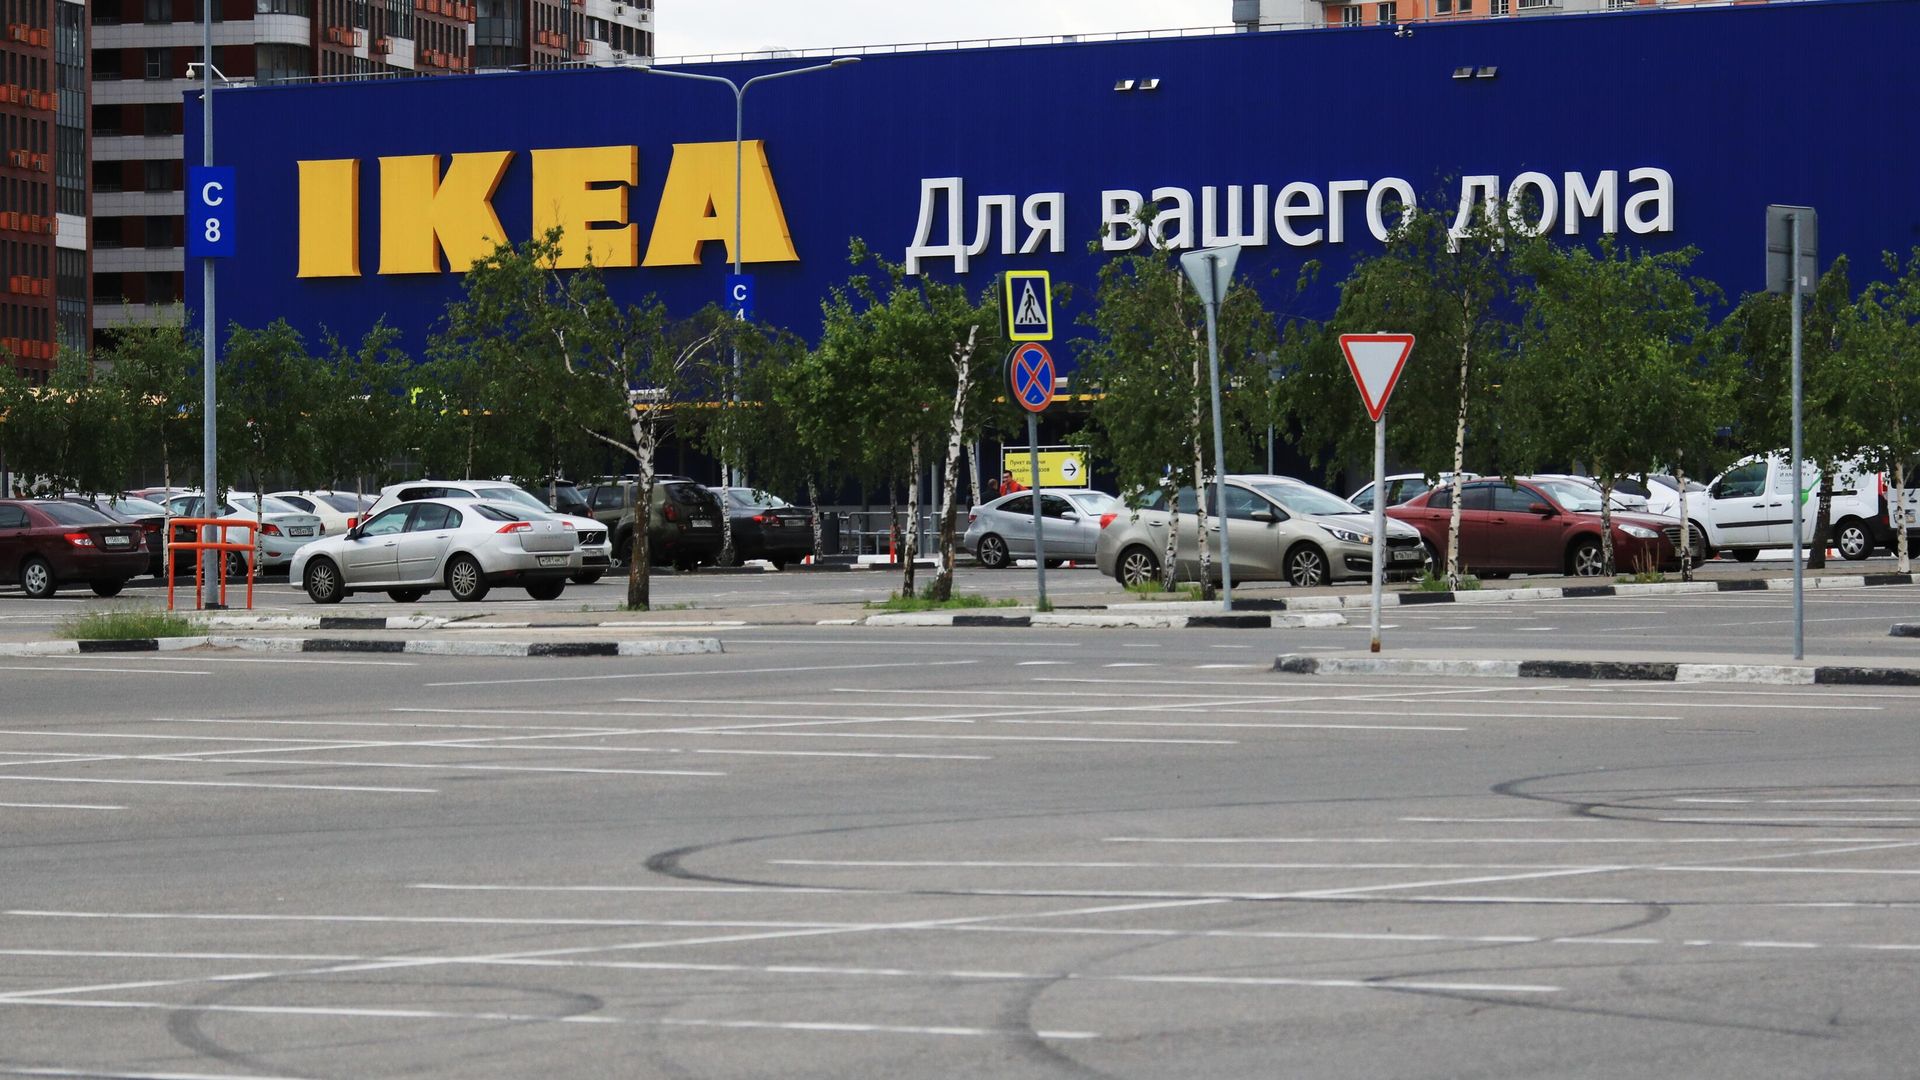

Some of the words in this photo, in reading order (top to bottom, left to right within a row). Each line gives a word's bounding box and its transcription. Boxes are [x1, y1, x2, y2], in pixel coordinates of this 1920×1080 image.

[205, 218, 221, 242] 8
[297, 139, 800, 278] IKEA
[905, 176, 1064, 275] Для
[1101, 177, 1417, 251] вашего
[1446, 167, 1674, 254] дома
[735, 308, 745, 321] 4
